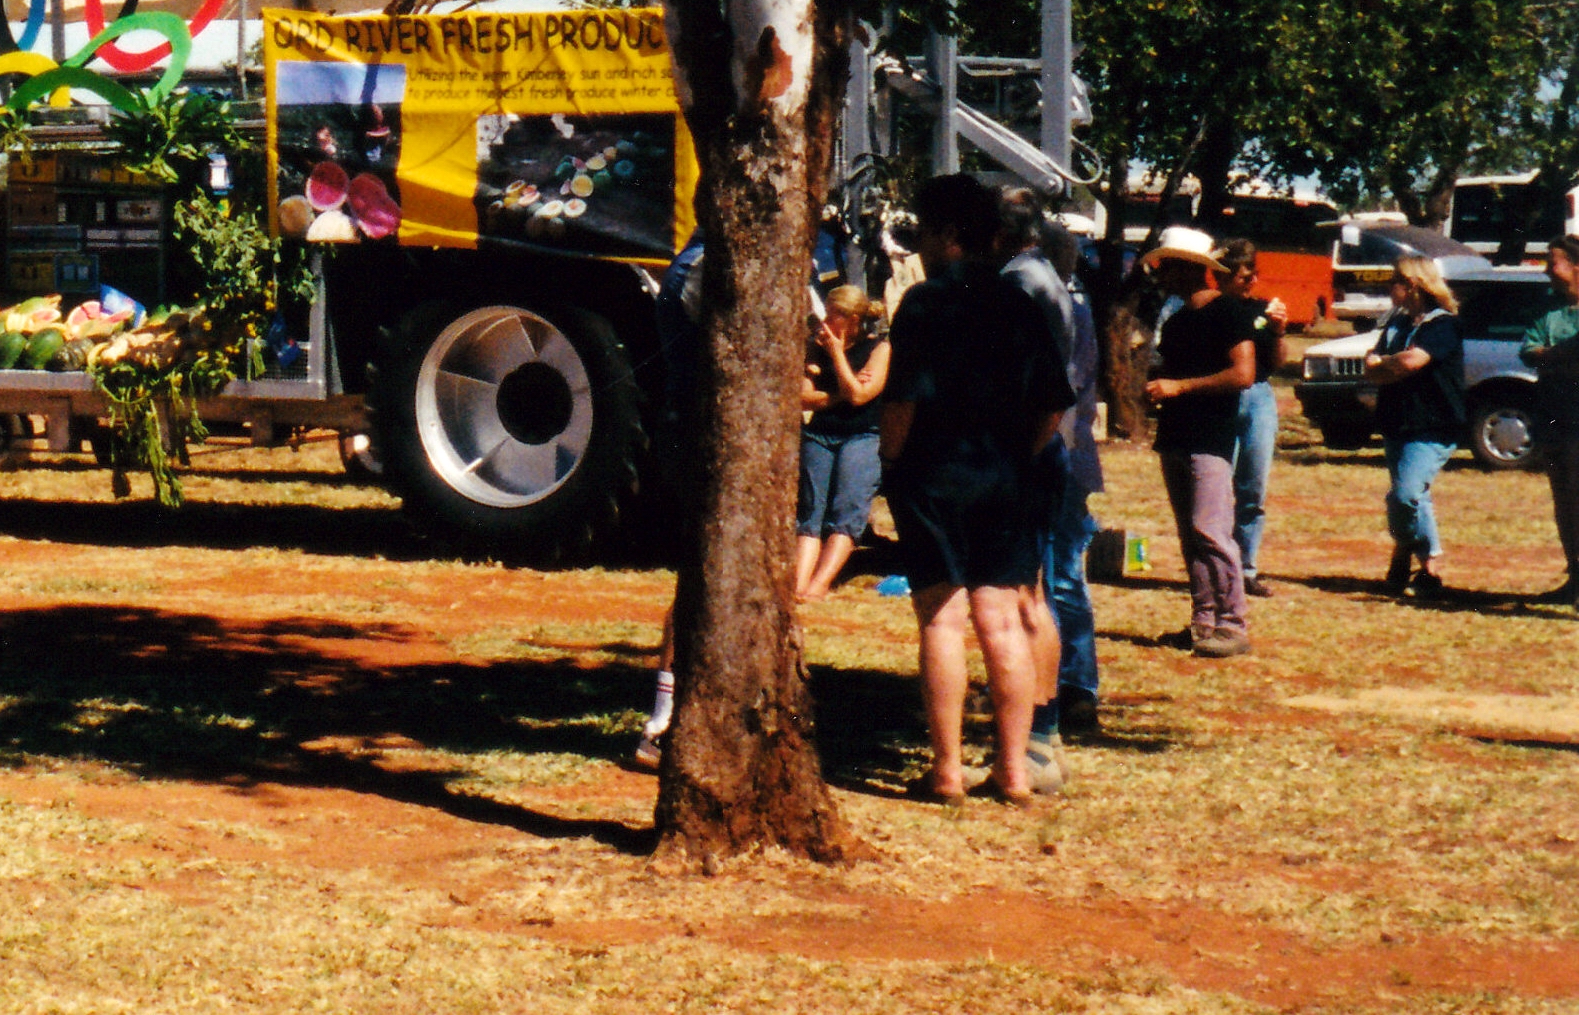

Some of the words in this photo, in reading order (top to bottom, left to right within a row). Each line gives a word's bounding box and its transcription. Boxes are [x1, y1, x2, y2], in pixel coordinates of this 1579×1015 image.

[274, 16, 334, 53] ORD
[344, 17, 431, 54] RIVER
[440, 14, 533, 54] FRESH
[545, 12, 663, 52] PRODUC
[580, 69, 600, 80] sun
[604, 66, 629, 80] and
[530, 85, 563, 99] fresh
